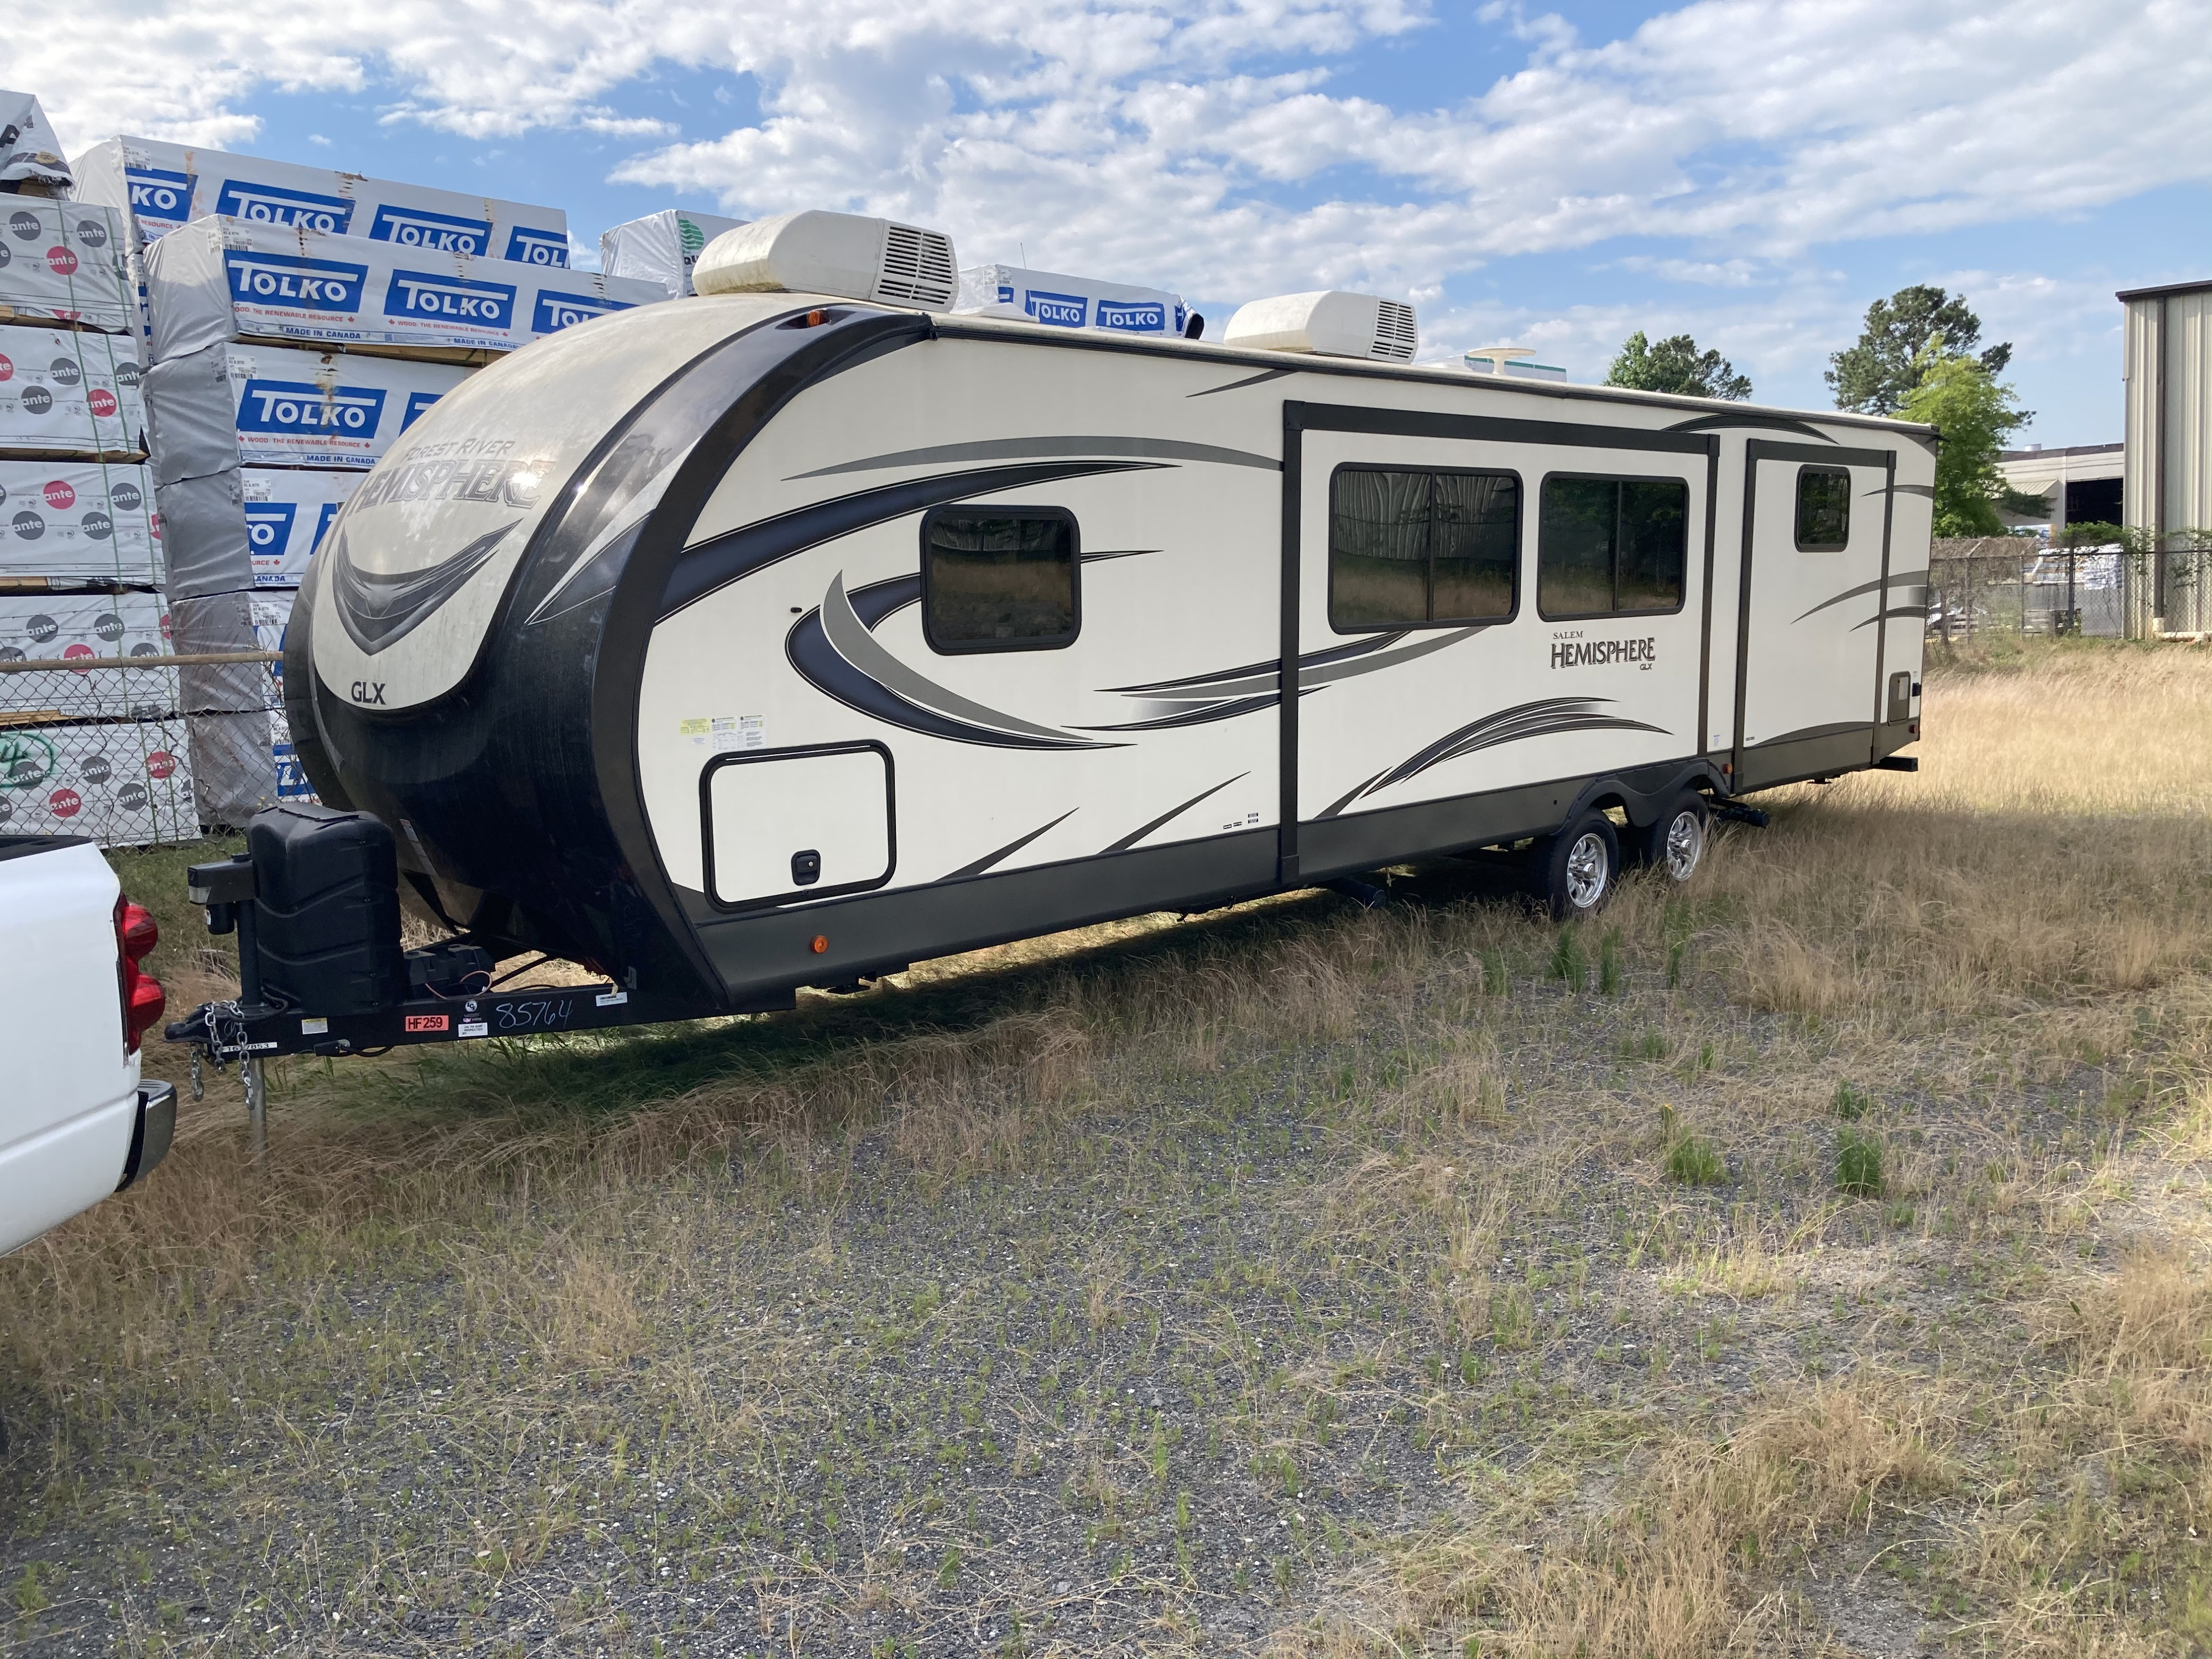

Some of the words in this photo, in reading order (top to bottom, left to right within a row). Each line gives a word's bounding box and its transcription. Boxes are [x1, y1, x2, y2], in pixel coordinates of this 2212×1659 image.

[228, 190, 346, 233] TOLKO
[11, 221, 39, 232] ante
[79, 228, 105, 238] ante
[382, 214, 485, 254] TOLKO
[517, 235, 570, 269] TOL
[48, 255, 76, 266] ante
[228, 259, 358, 301] TOLKO
[398, 279, 508, 319] TOLKO
[265, 310, 306, 319] RENEWABLE
[1030, 296, 1084, 323] TOLKO
[1100, 306, 1161, 326] TOLKO
[326, 331, 361, 339] CANADA
[471, 327, 499, 336] RESOURCE
[489, 341, 518, 349] CANADA
[52, 367, 79, 378] ante
[116, 372, 139, 383] ant
[22, 394, 50, 405] ante
[252, 390, 377, 428] TOLKO
[401, 442, 459, 462] FOREST
[456, 439, 515, 455] RIVER
[347, 460, 556, 516] HEMISPHERE
[45, 489, 73, 501] ante
[112, 492, 140, 503] ante
[14, 520, 43, 533] ante
[82, 520, 111, 532] ante
[28, 623, 57, 636] ante
[96, 622, 122, 634] ante
[1553, 630, 1583, 639] SALEM
[1551, 637, 1656, 669] HEMISPHERE
[351, 681, 387, 705] GLX
[51, 797, 79, 810] ante
[496, 999, 573, 1029] 85764
[227, 1043, 269, 1051] 167853
